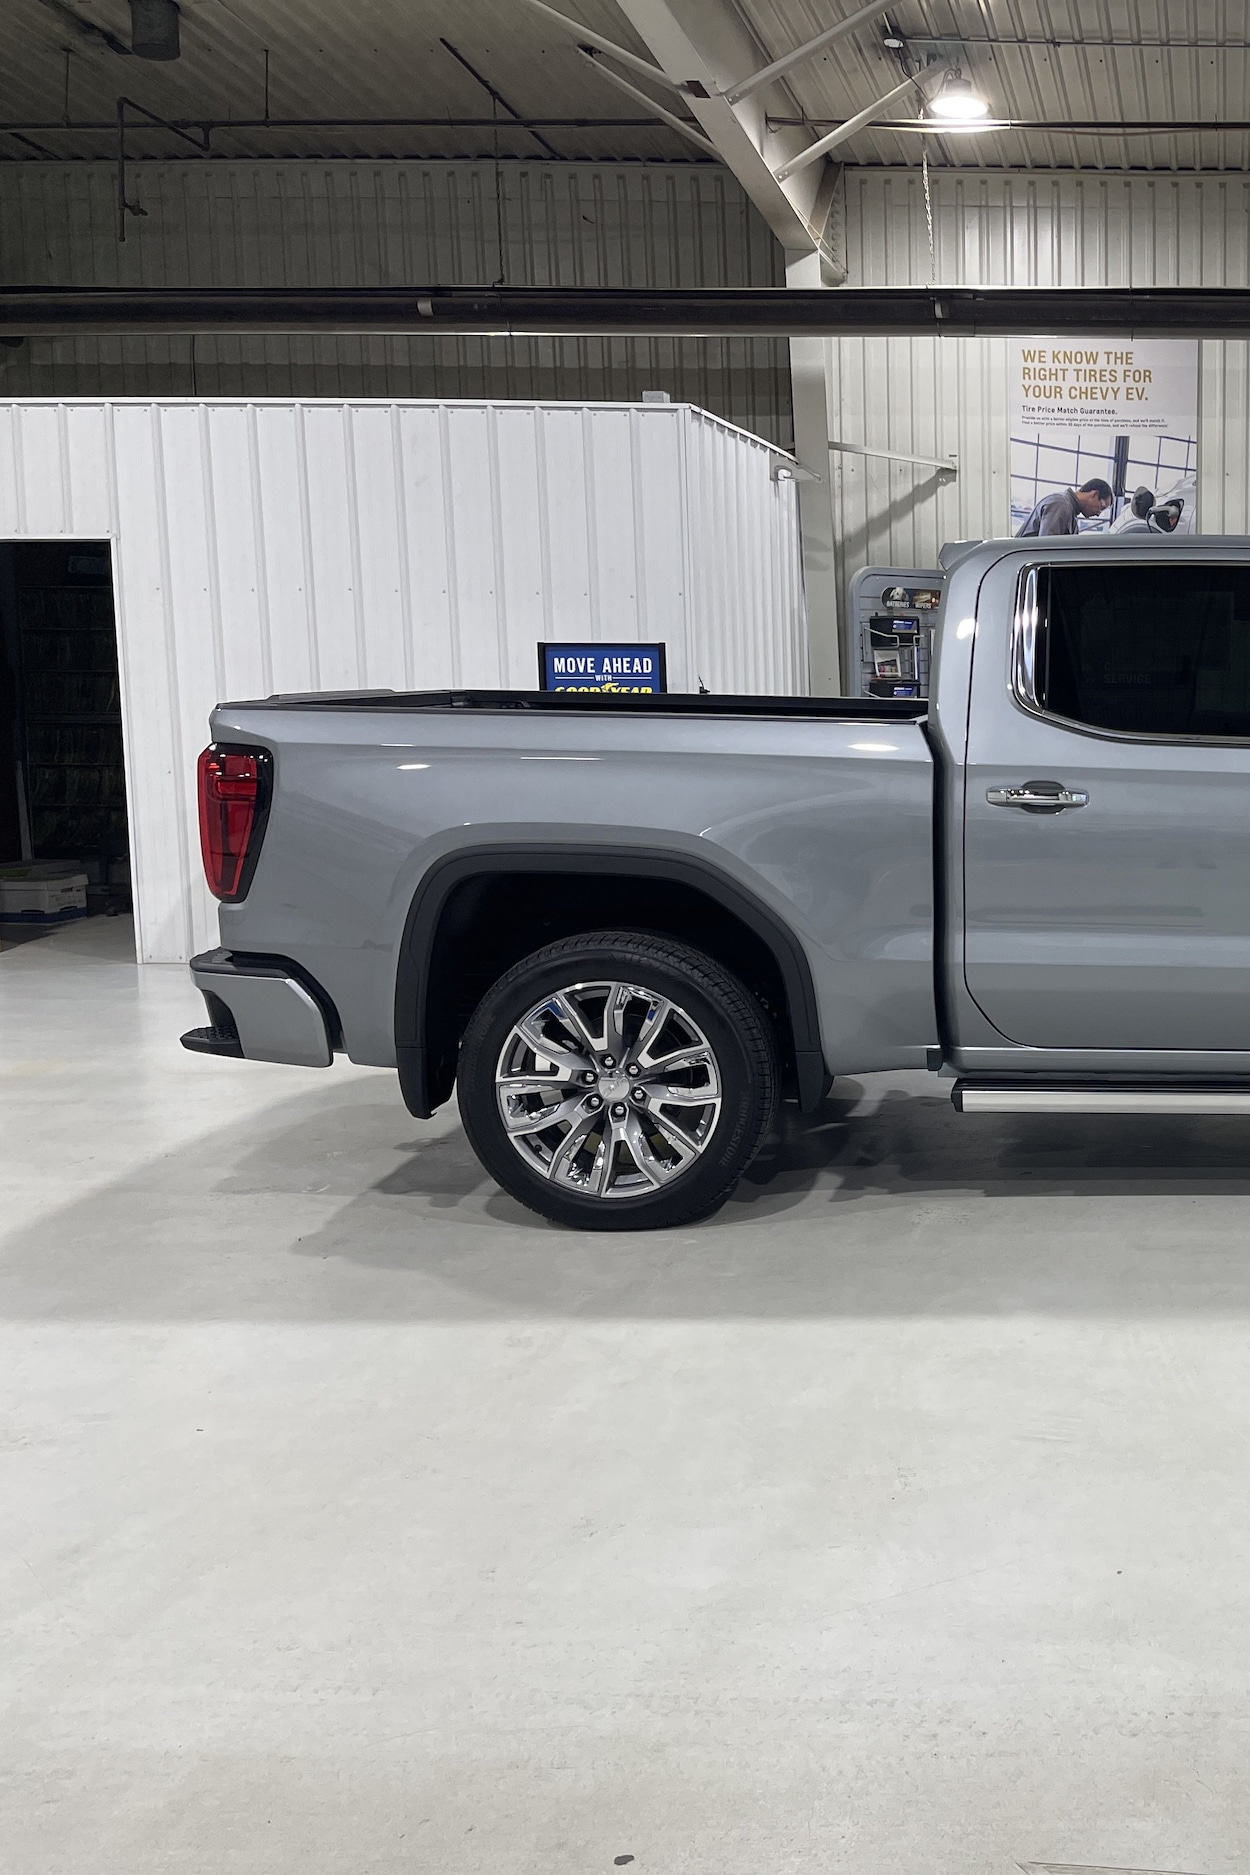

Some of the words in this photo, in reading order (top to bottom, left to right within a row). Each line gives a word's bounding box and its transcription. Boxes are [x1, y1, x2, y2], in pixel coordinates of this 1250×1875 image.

[1022, 350, 1047, 364] WE
[1052, 350, 1099, 365] KNOW
[1104, 351, 1134, 365] THE
[1022, 367, 1068, 382] RIGHT
[1074, 368, 1118, 383] TIRES
[1123, 369, 1152, 384] FOR
[1022, 384, 1063, 399] YOUR
[1068, 386, 1121, 400] CHEVY
[1126, 387, 1149, 401] EV.
[1021, 404, 1036, 413] Tire
[1037, 405, 1056, 413] Price
[1057, 406, 1079, 414] Match
[1080, 407, 1118, 415] Guarantee.
[553, 657, 596, 673] MOVE
[602, 657, 653, 673] AHEAD
[595, 674, 613, 682] WITH
